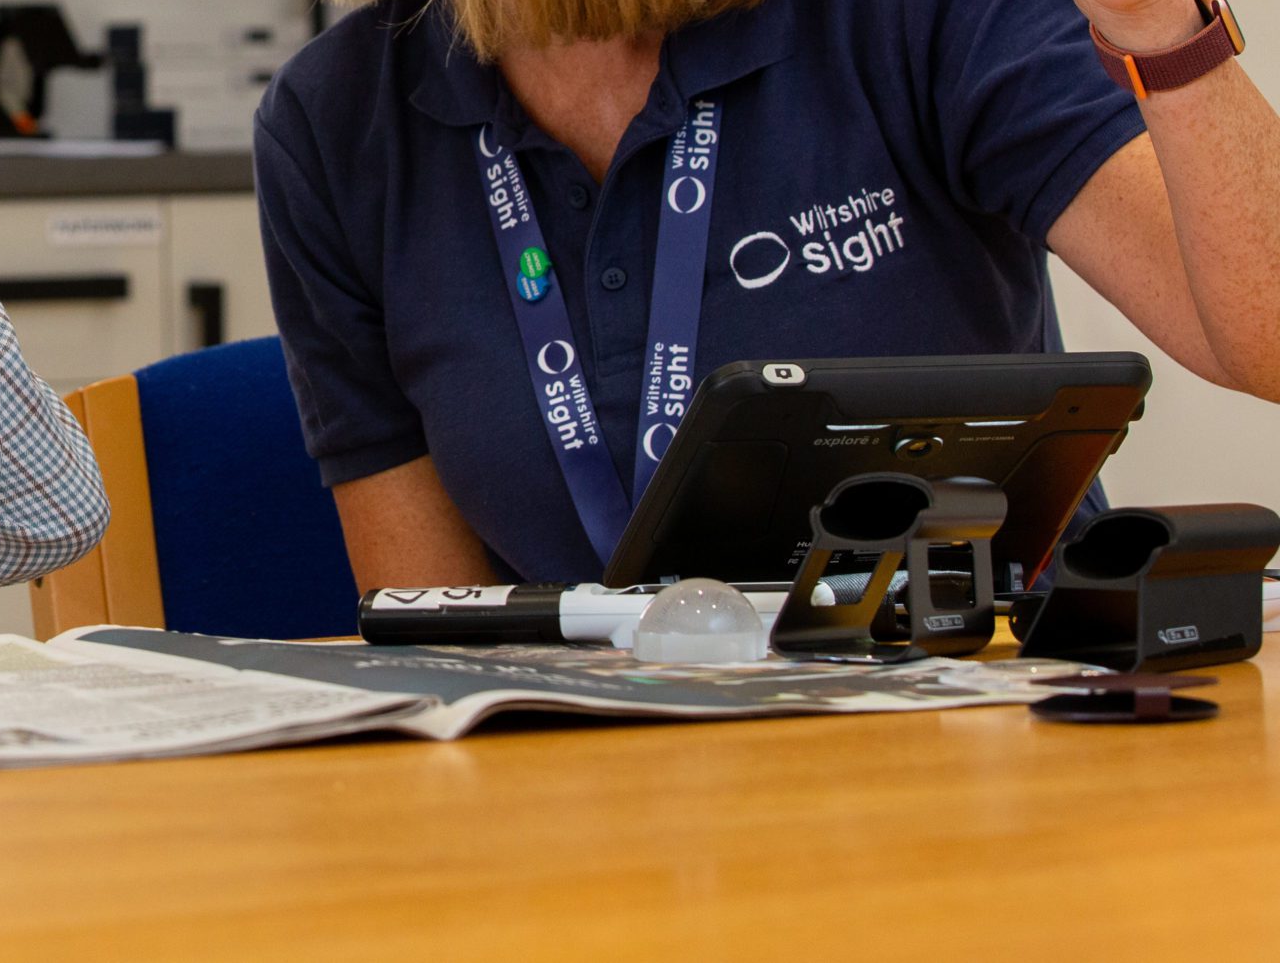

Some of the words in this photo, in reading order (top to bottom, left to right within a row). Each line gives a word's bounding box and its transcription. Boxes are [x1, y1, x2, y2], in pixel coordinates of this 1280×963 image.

[688, 100, 718, 170] sight
[487, 163, 518, 230] sight
[789, 187, 895, 236] Wiltshire
[802, 211, 904, 273] sight
[664, 344, 692, 417] sight
[545, 380, 585, 451] sight
